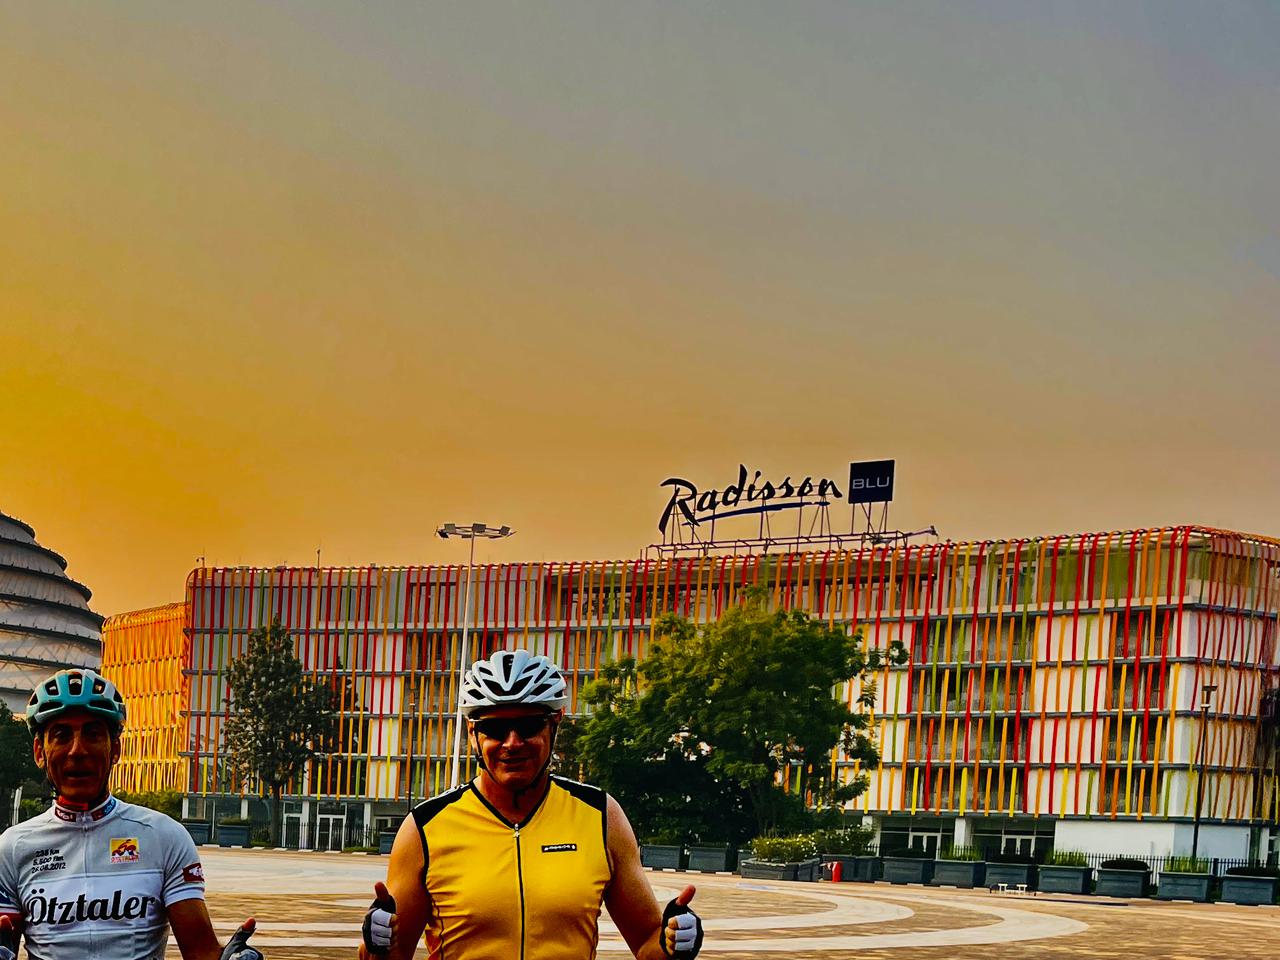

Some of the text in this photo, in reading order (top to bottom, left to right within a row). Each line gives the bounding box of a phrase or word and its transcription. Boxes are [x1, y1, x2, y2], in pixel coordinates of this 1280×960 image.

[658, 463, 890, 534] Radisson BLU
[26, 888, 155, 926] Ötztaler
